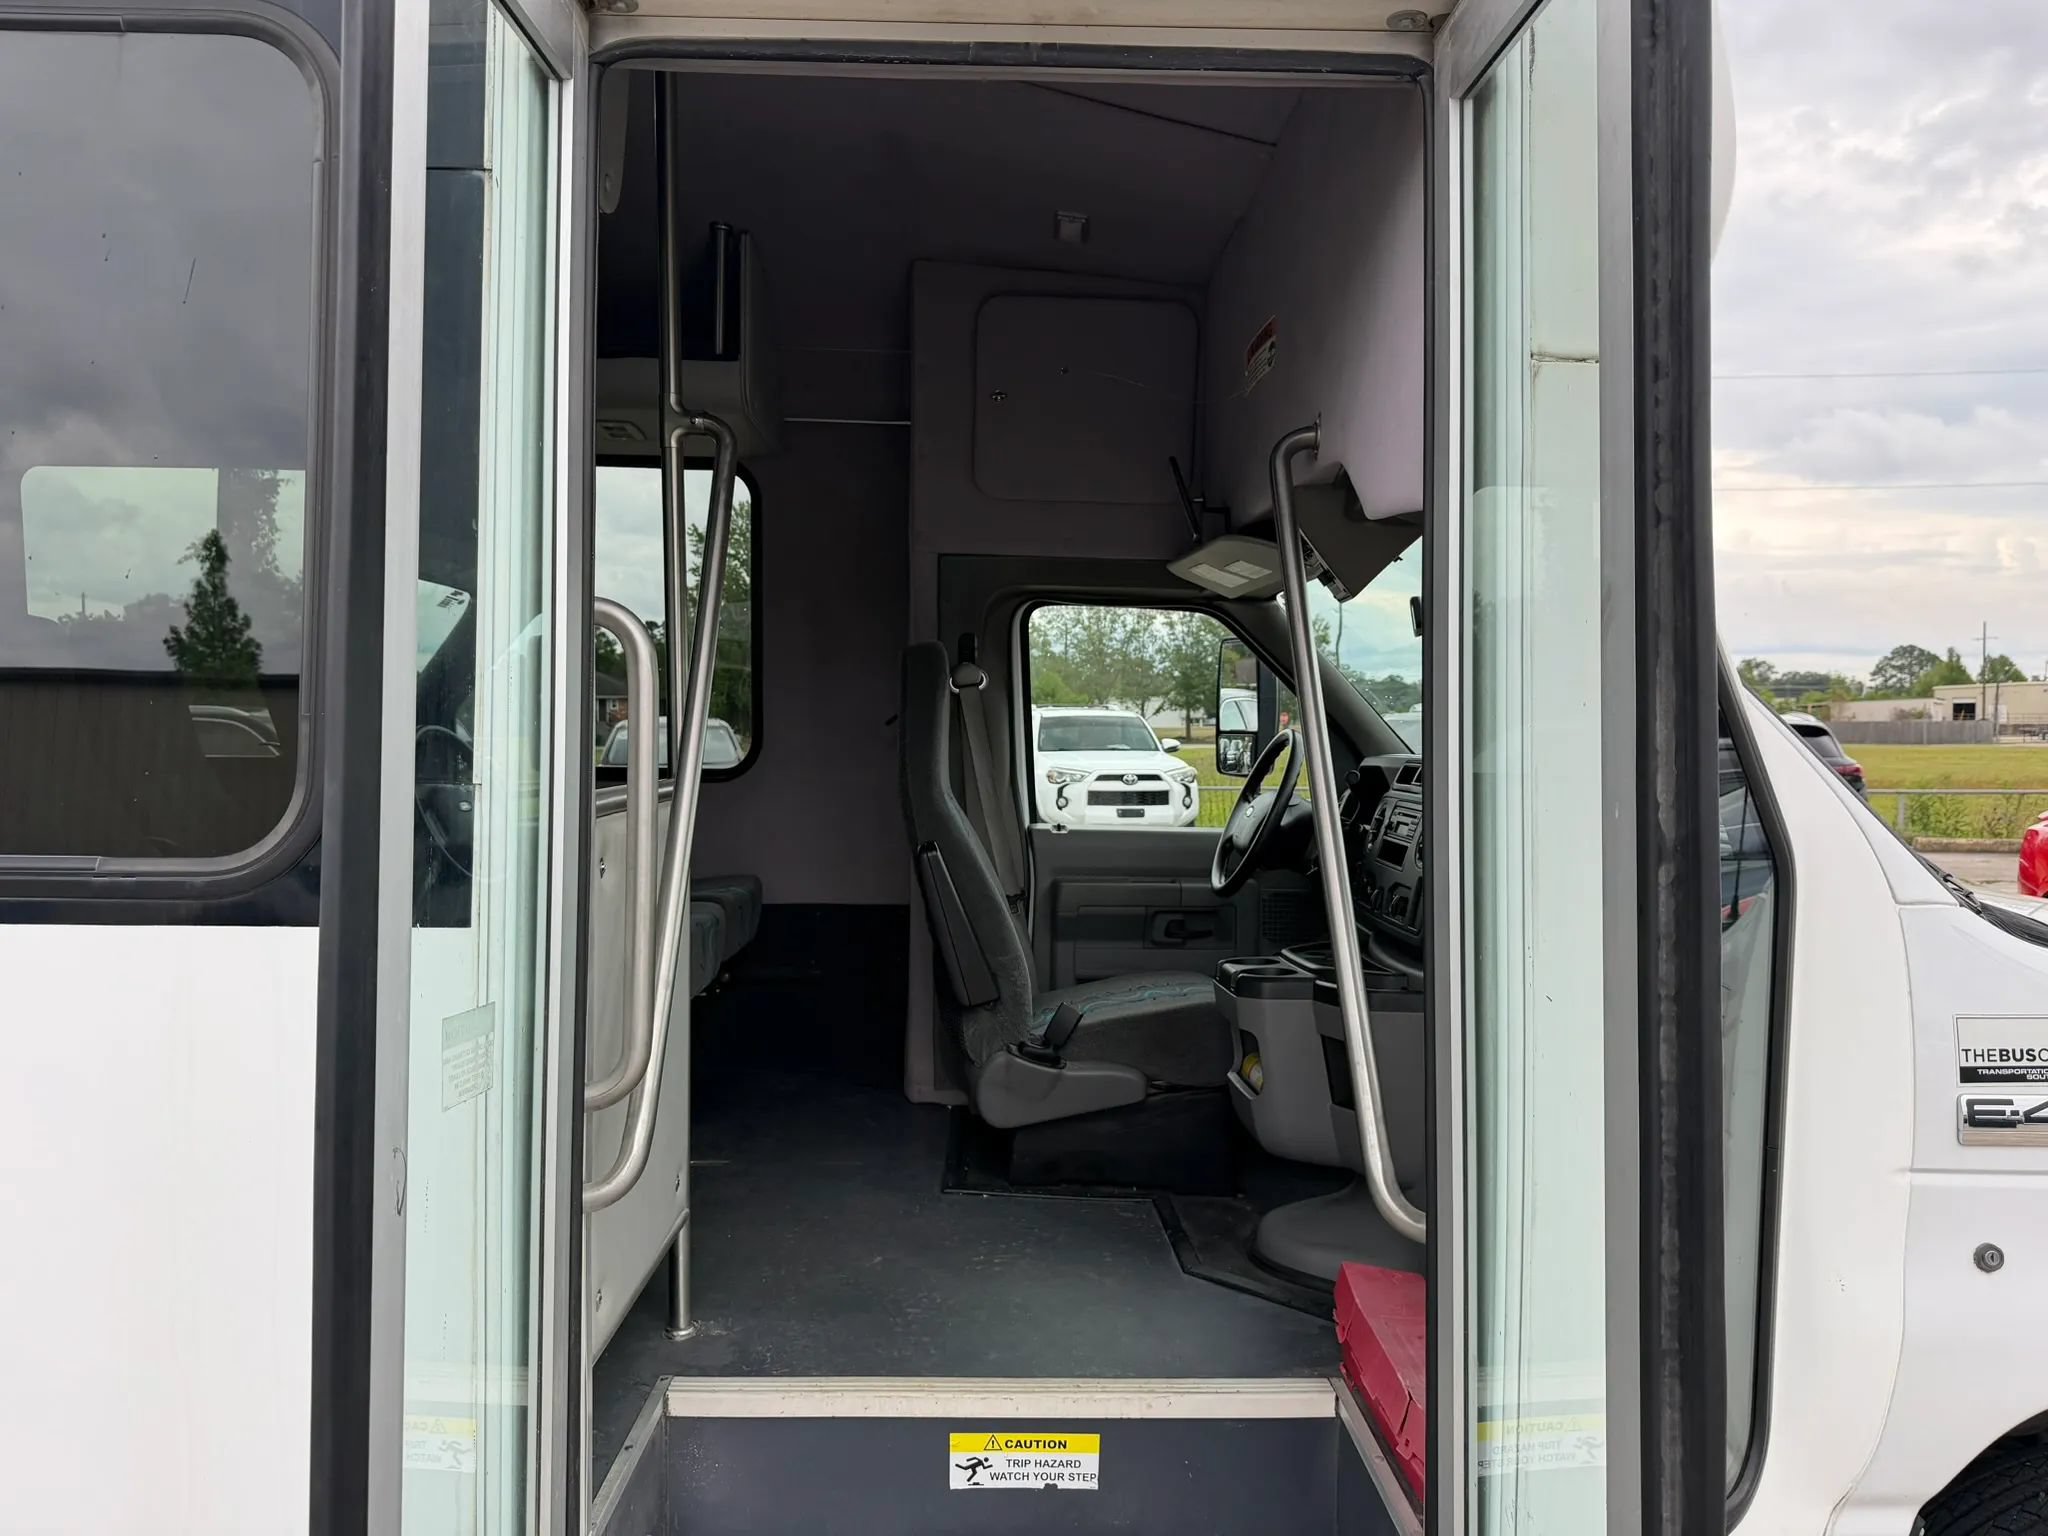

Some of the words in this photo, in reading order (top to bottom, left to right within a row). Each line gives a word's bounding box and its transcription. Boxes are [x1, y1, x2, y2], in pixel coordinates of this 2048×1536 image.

[1004, 1439, 1068, 1449] CAUTION
[1006, 1459, 1031, 1468] TRIP
[1034, 1459, 1082, 1469] HAZARD
[989, 1472, 1030, 1481] WATCH
[1033, 1472, 1065, 1481] YOUR
[1068, 1472, 1097, 1482] STEP
